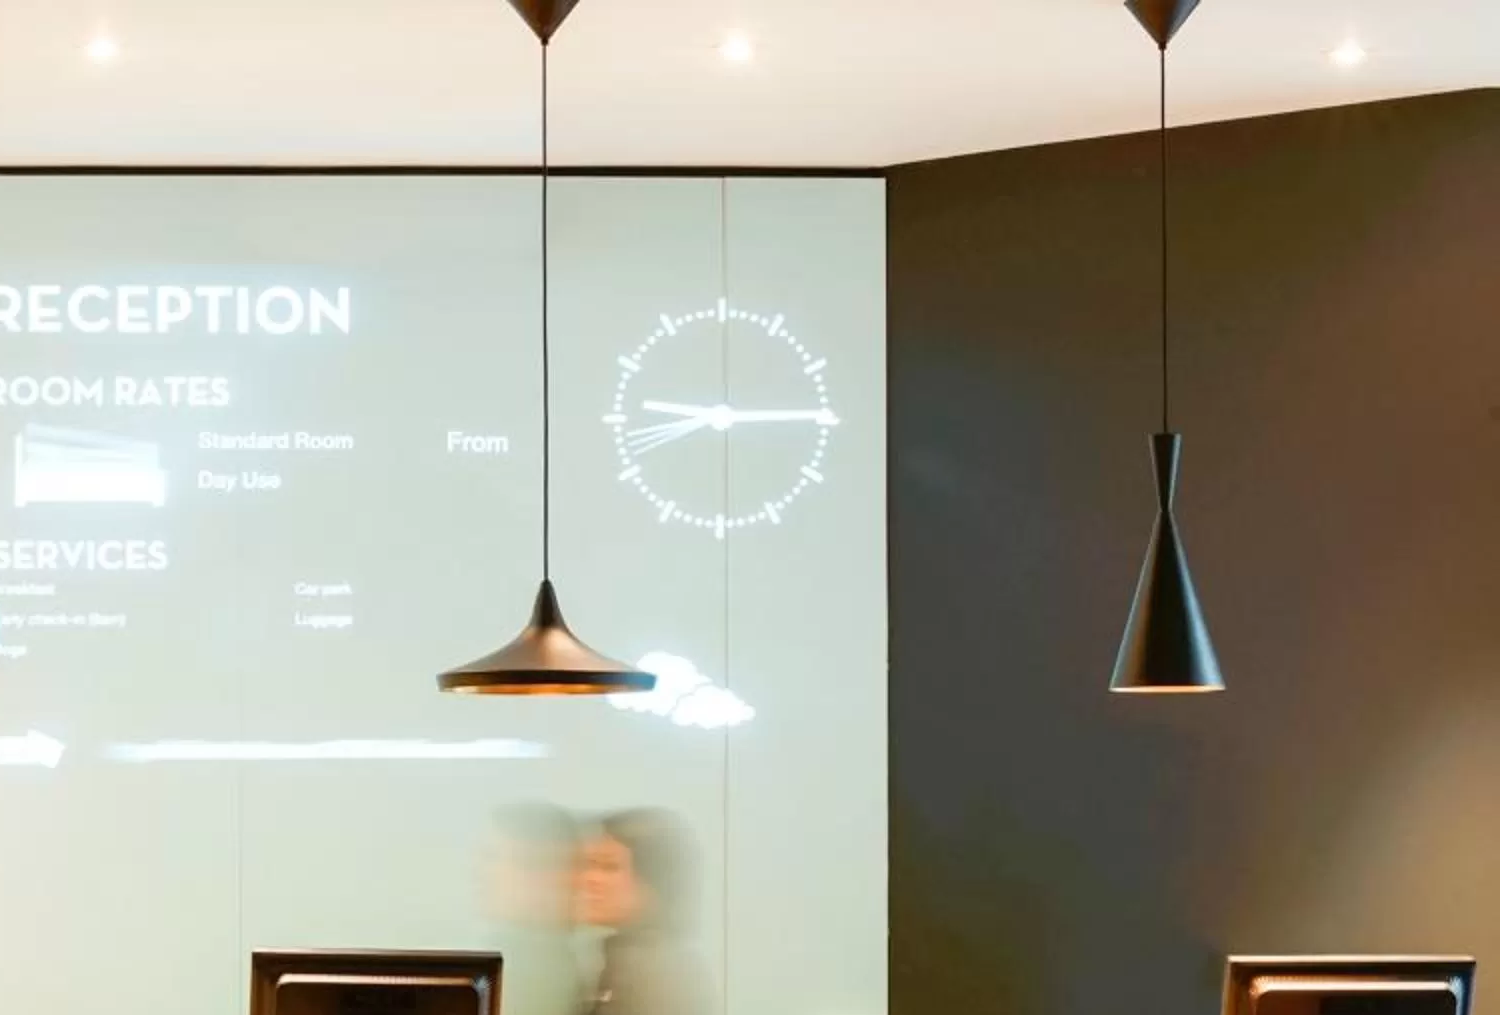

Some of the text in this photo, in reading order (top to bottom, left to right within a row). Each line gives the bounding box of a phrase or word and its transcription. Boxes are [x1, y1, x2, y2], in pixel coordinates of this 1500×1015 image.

[113, 375, 231, 407] RATES
[198, 430, 354, 450] Standard Room
[446, 430, 509, 454] From
[198, 469, 281, 492] Day Use
